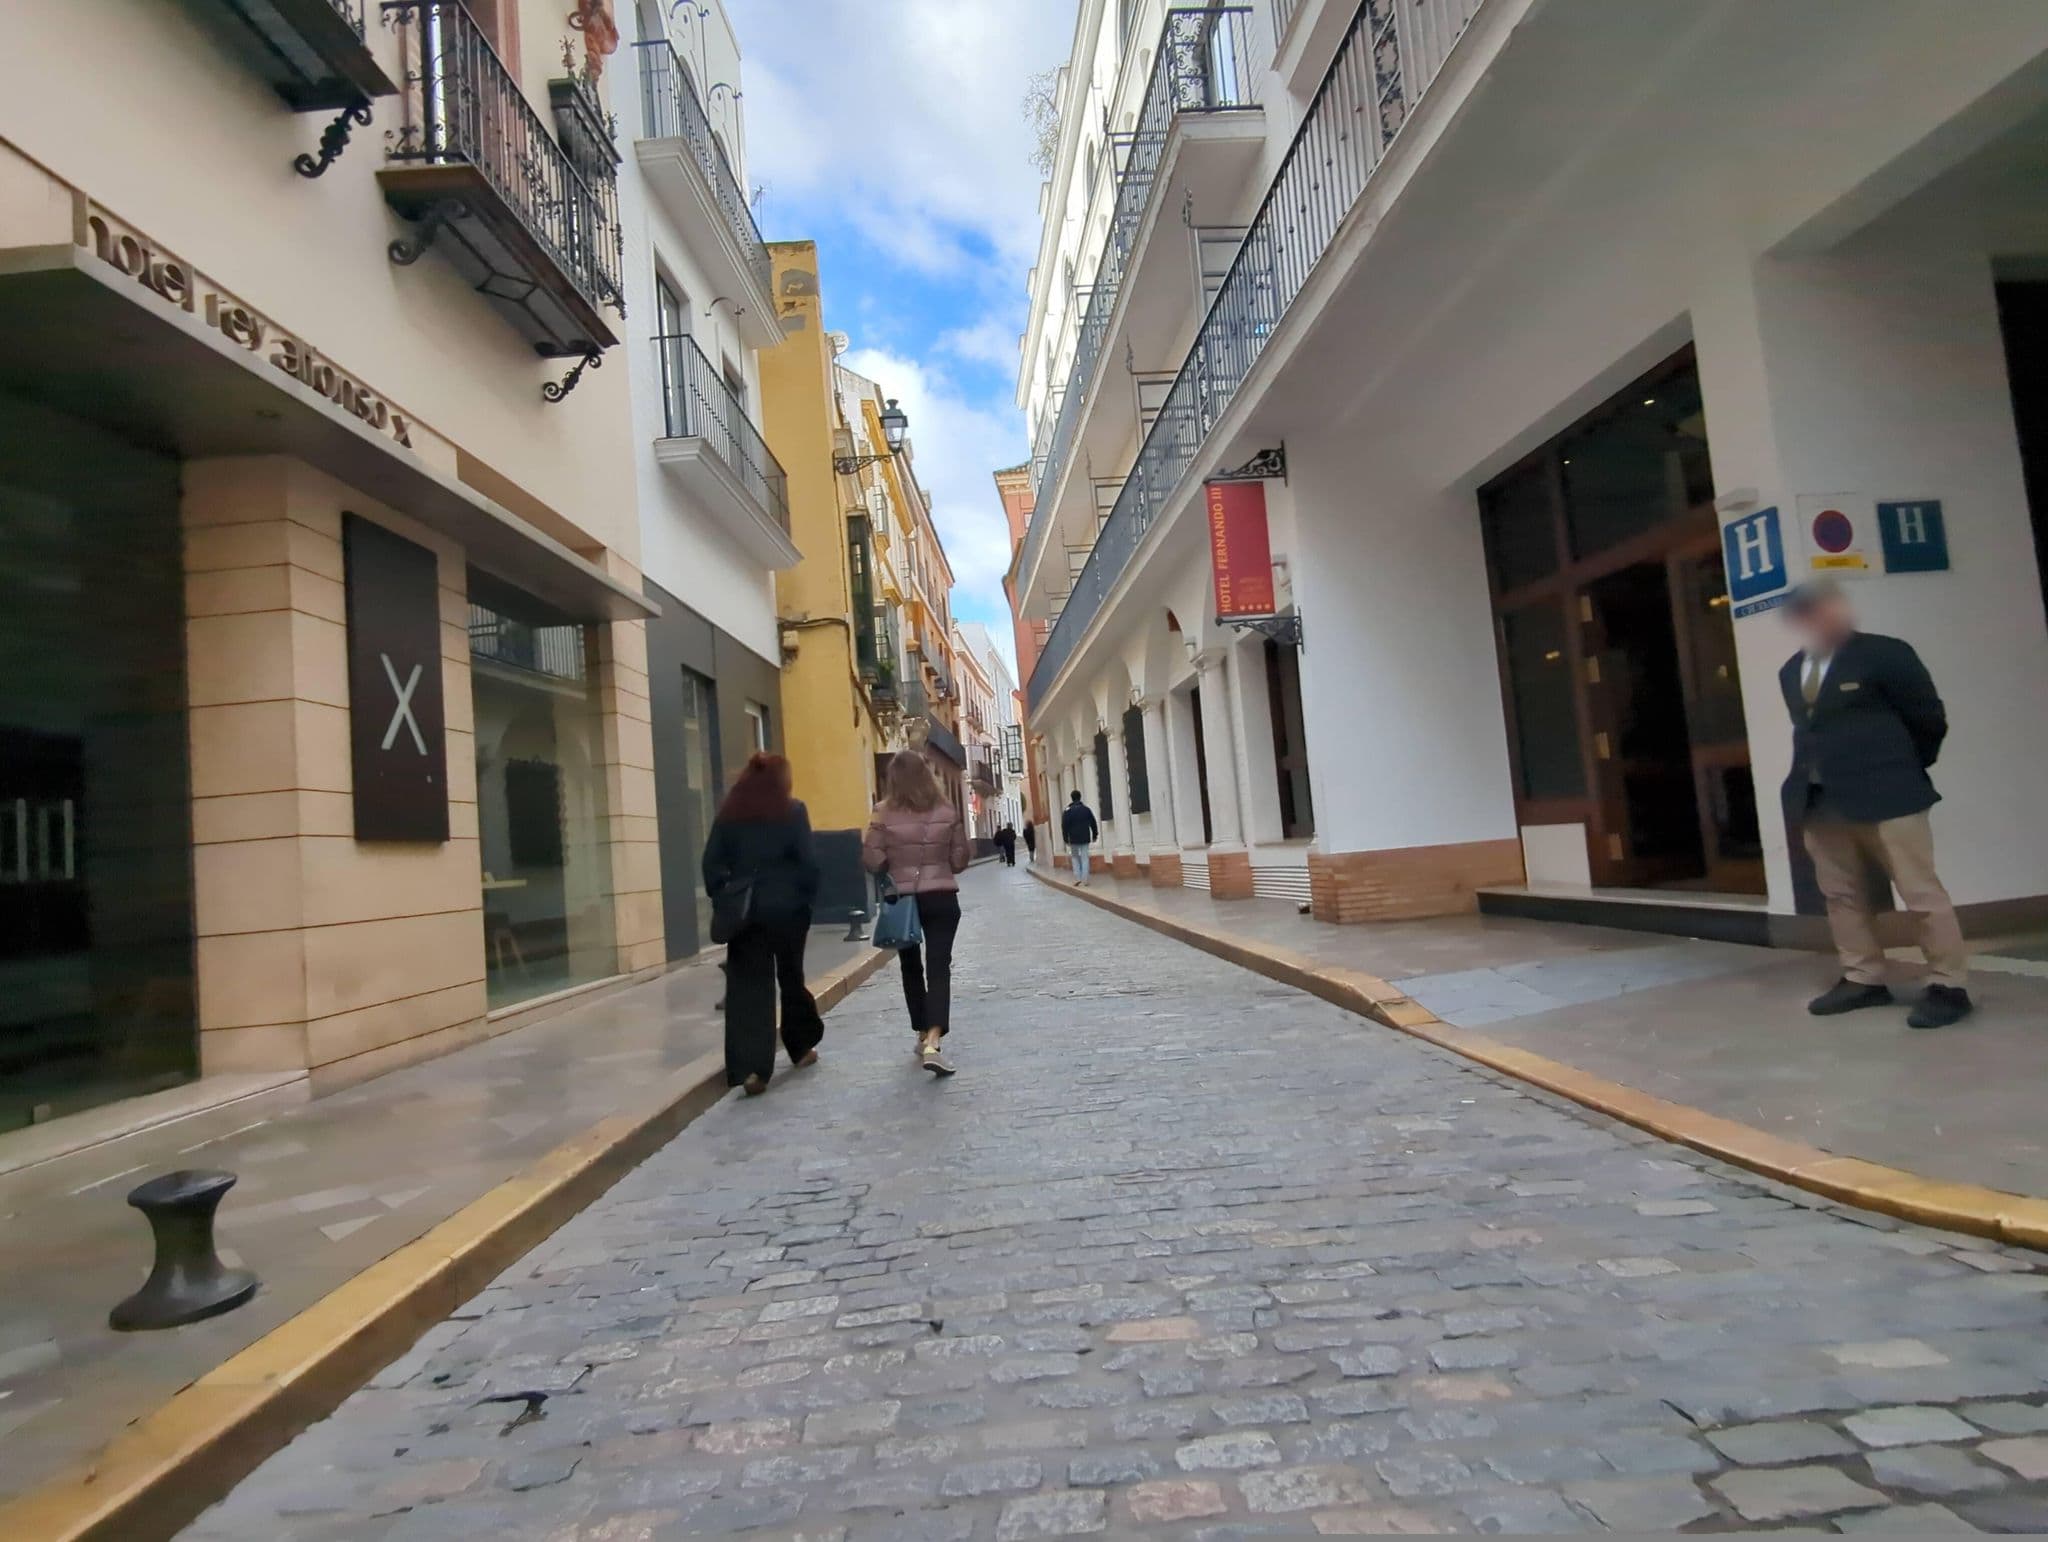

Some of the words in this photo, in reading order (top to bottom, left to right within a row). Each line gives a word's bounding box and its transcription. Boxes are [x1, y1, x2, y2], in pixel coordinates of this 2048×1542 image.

[71, 190, 195, 313] hotel
[204, 293, 266, 351] rey
[268, 337, 389, 430] alfonso
[1210, 487, 1223, 500] III
[1897, 507, 1926, 544] H
[1213, 503, 1228, 570] FERNANDO
[1734, 515, 1775, 580] H
[1219, 574, 1232, 613] HOTEL
[380, 652, 428, 756] X
